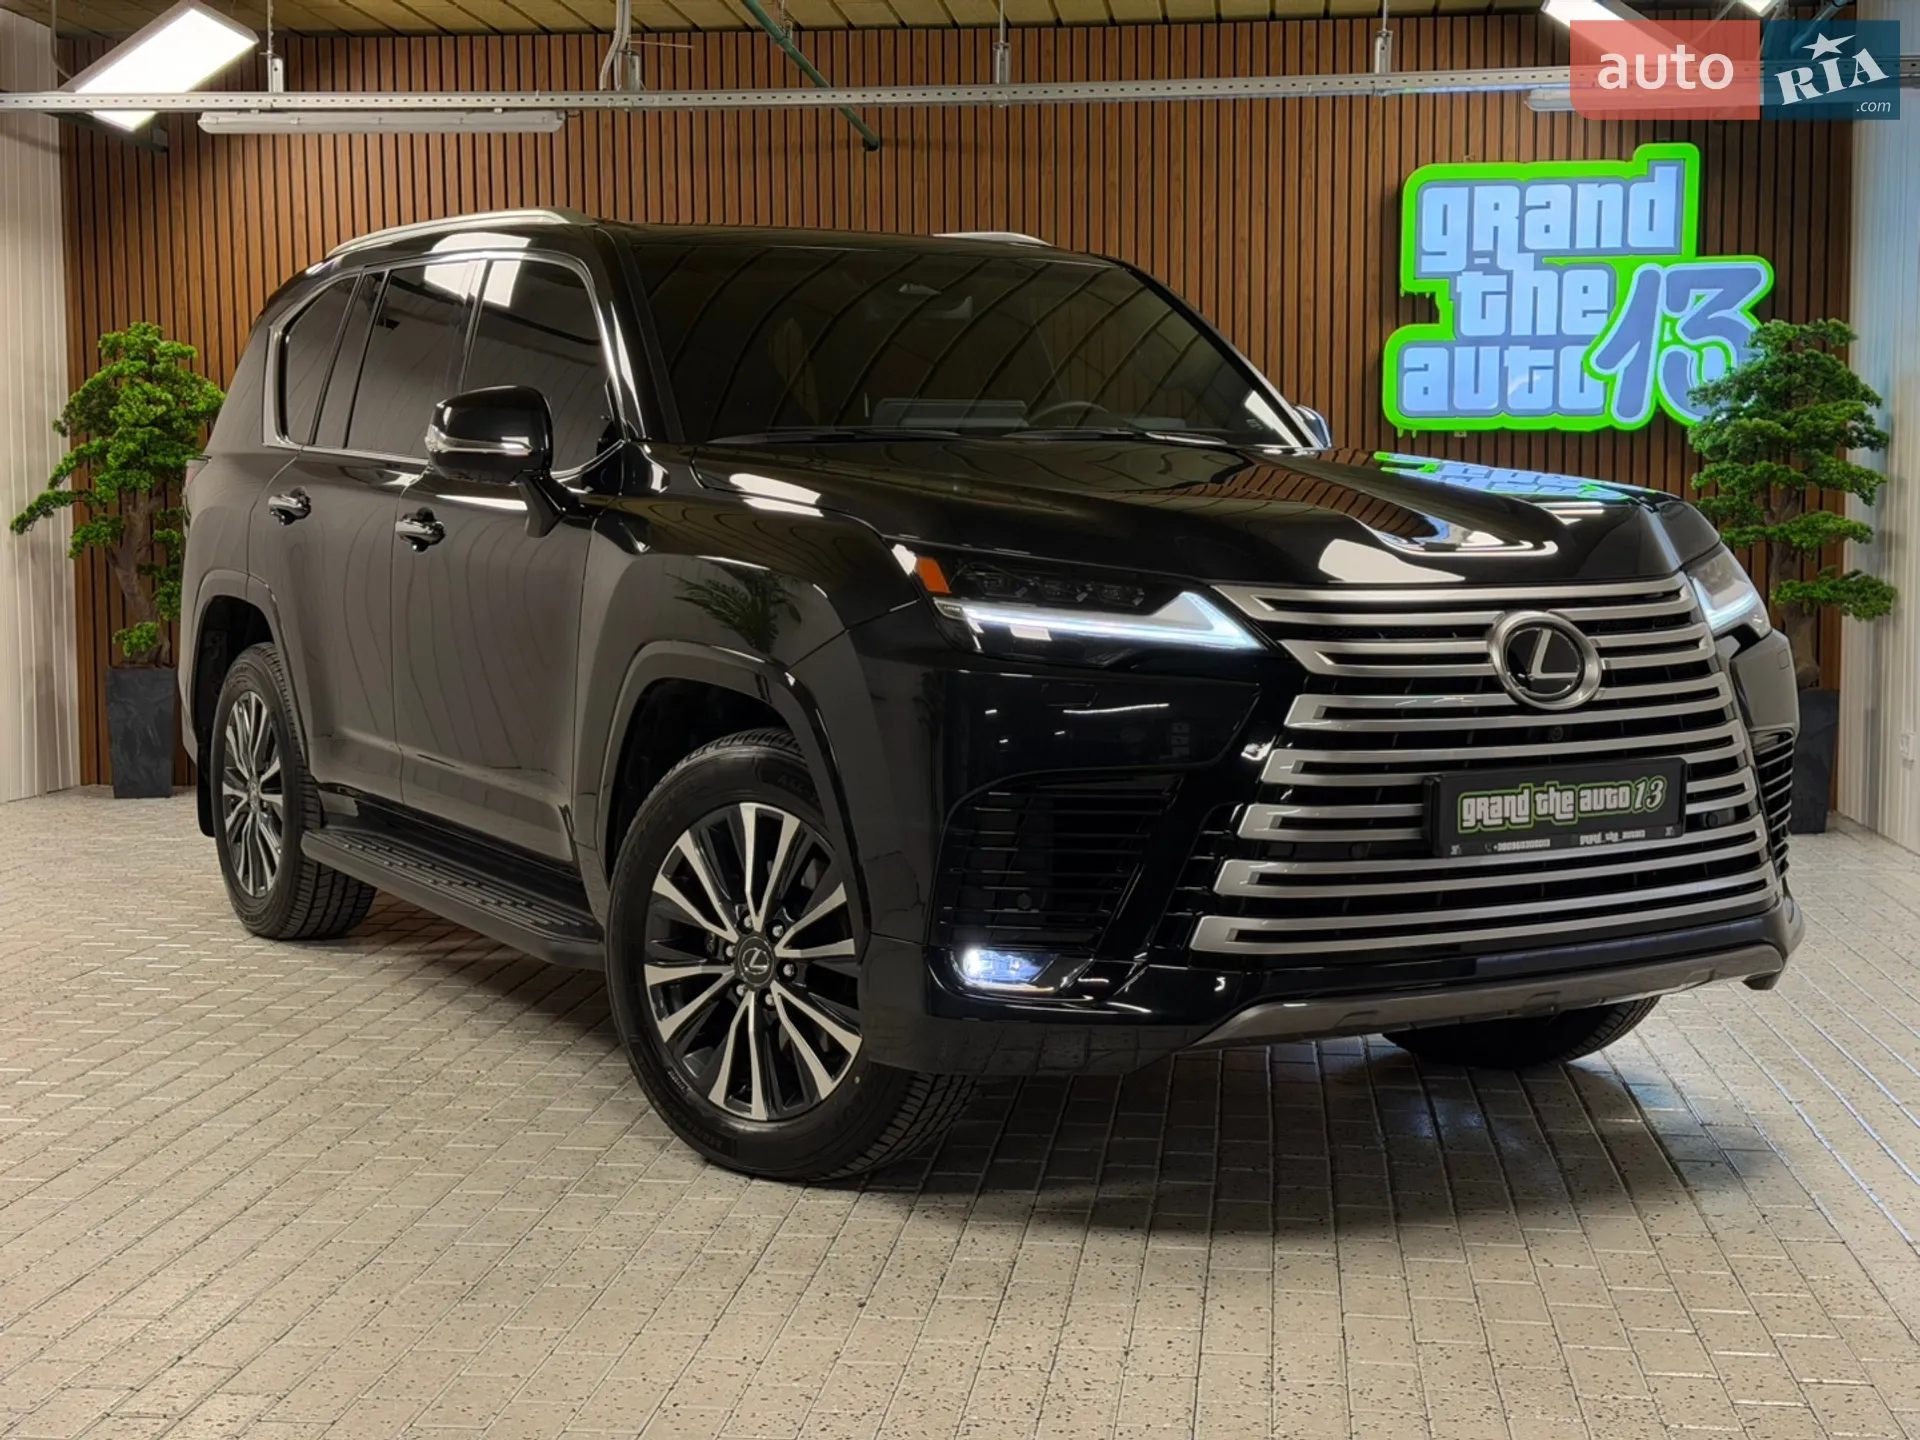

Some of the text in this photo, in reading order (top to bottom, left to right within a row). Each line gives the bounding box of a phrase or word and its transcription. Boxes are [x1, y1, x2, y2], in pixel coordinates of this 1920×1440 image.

[1456, 252, 1767, 425] the 13
[1403, 345, 1606, 411] auto
[1534, 785, 1575, 820] the
